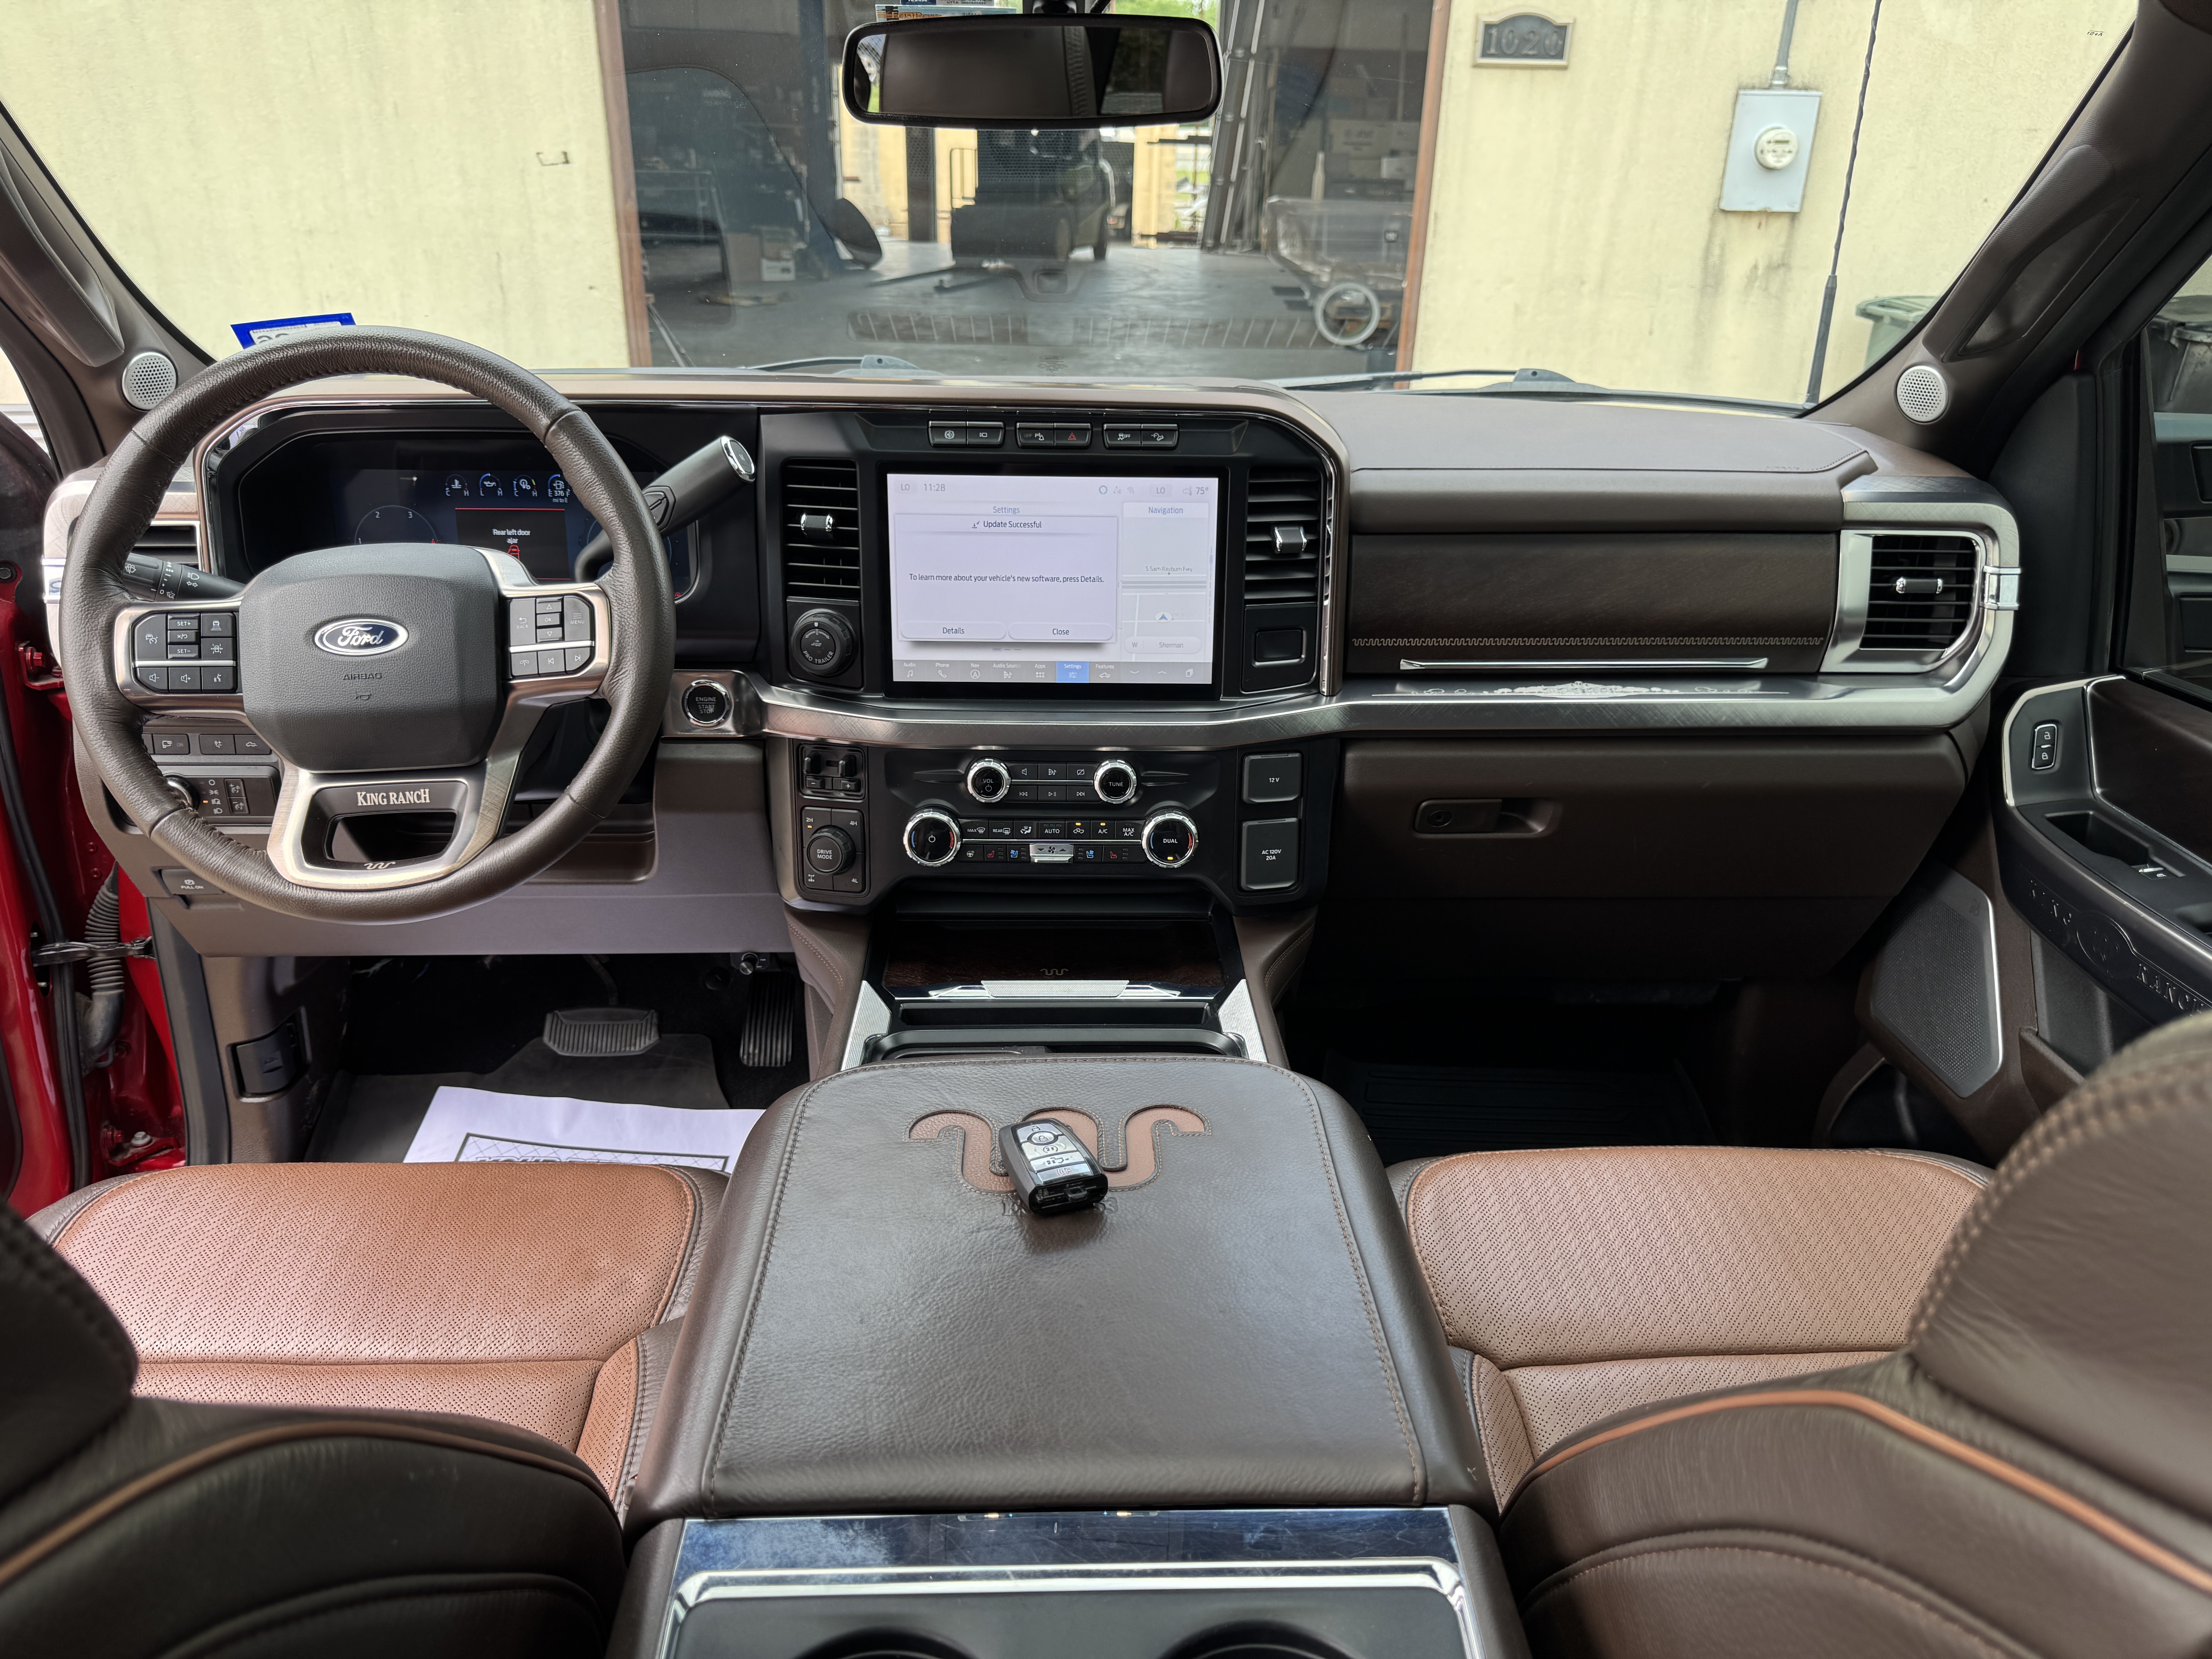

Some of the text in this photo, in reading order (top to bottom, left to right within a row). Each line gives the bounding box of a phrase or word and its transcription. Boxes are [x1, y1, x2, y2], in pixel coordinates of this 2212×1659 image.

[1486, 27, 1563, 56] 1020
[993, 506, 1020, 515] Settings
[1148, 507, 1183, 515] Navigation
[983, 520, 1007, 529] Update
[337, 626, 384, 646] Ford
[802, 651, 834, 664] PRO TRAILER
[343, 672, 383, 680] AIRBAG
[357, 788, 430, 806] KING RANCH
